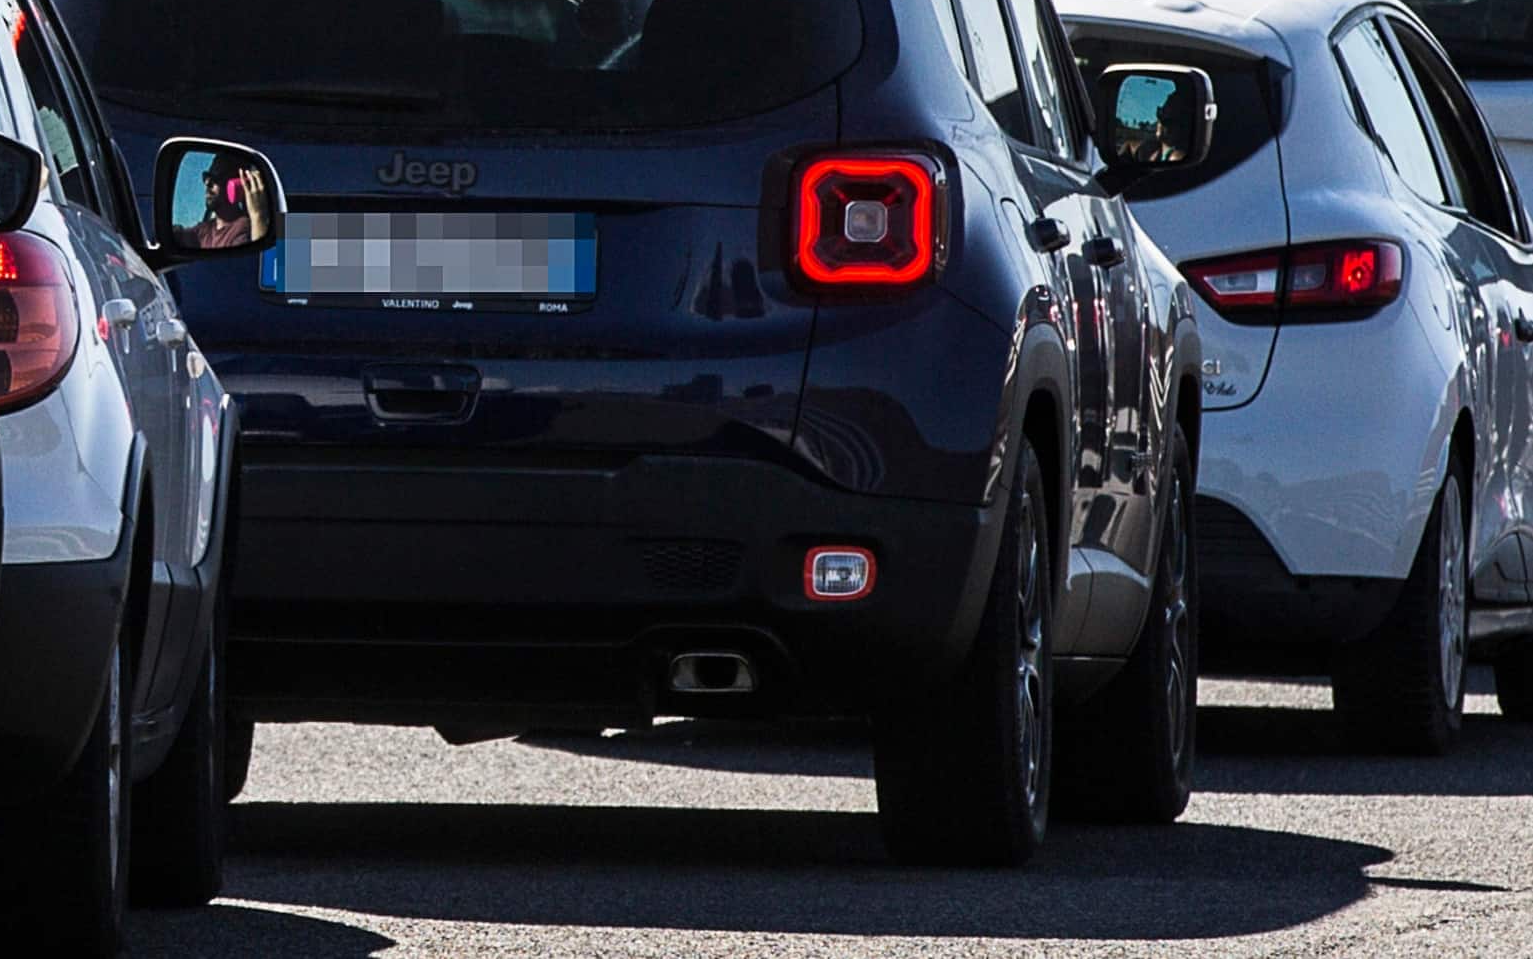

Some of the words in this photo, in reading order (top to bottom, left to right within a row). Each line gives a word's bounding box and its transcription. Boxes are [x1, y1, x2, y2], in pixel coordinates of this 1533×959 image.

[377, 152, 477, 191] Jeep
[381, 297, 441, 310] VALENTINO
[538, 302, 569, 313] ROMA
